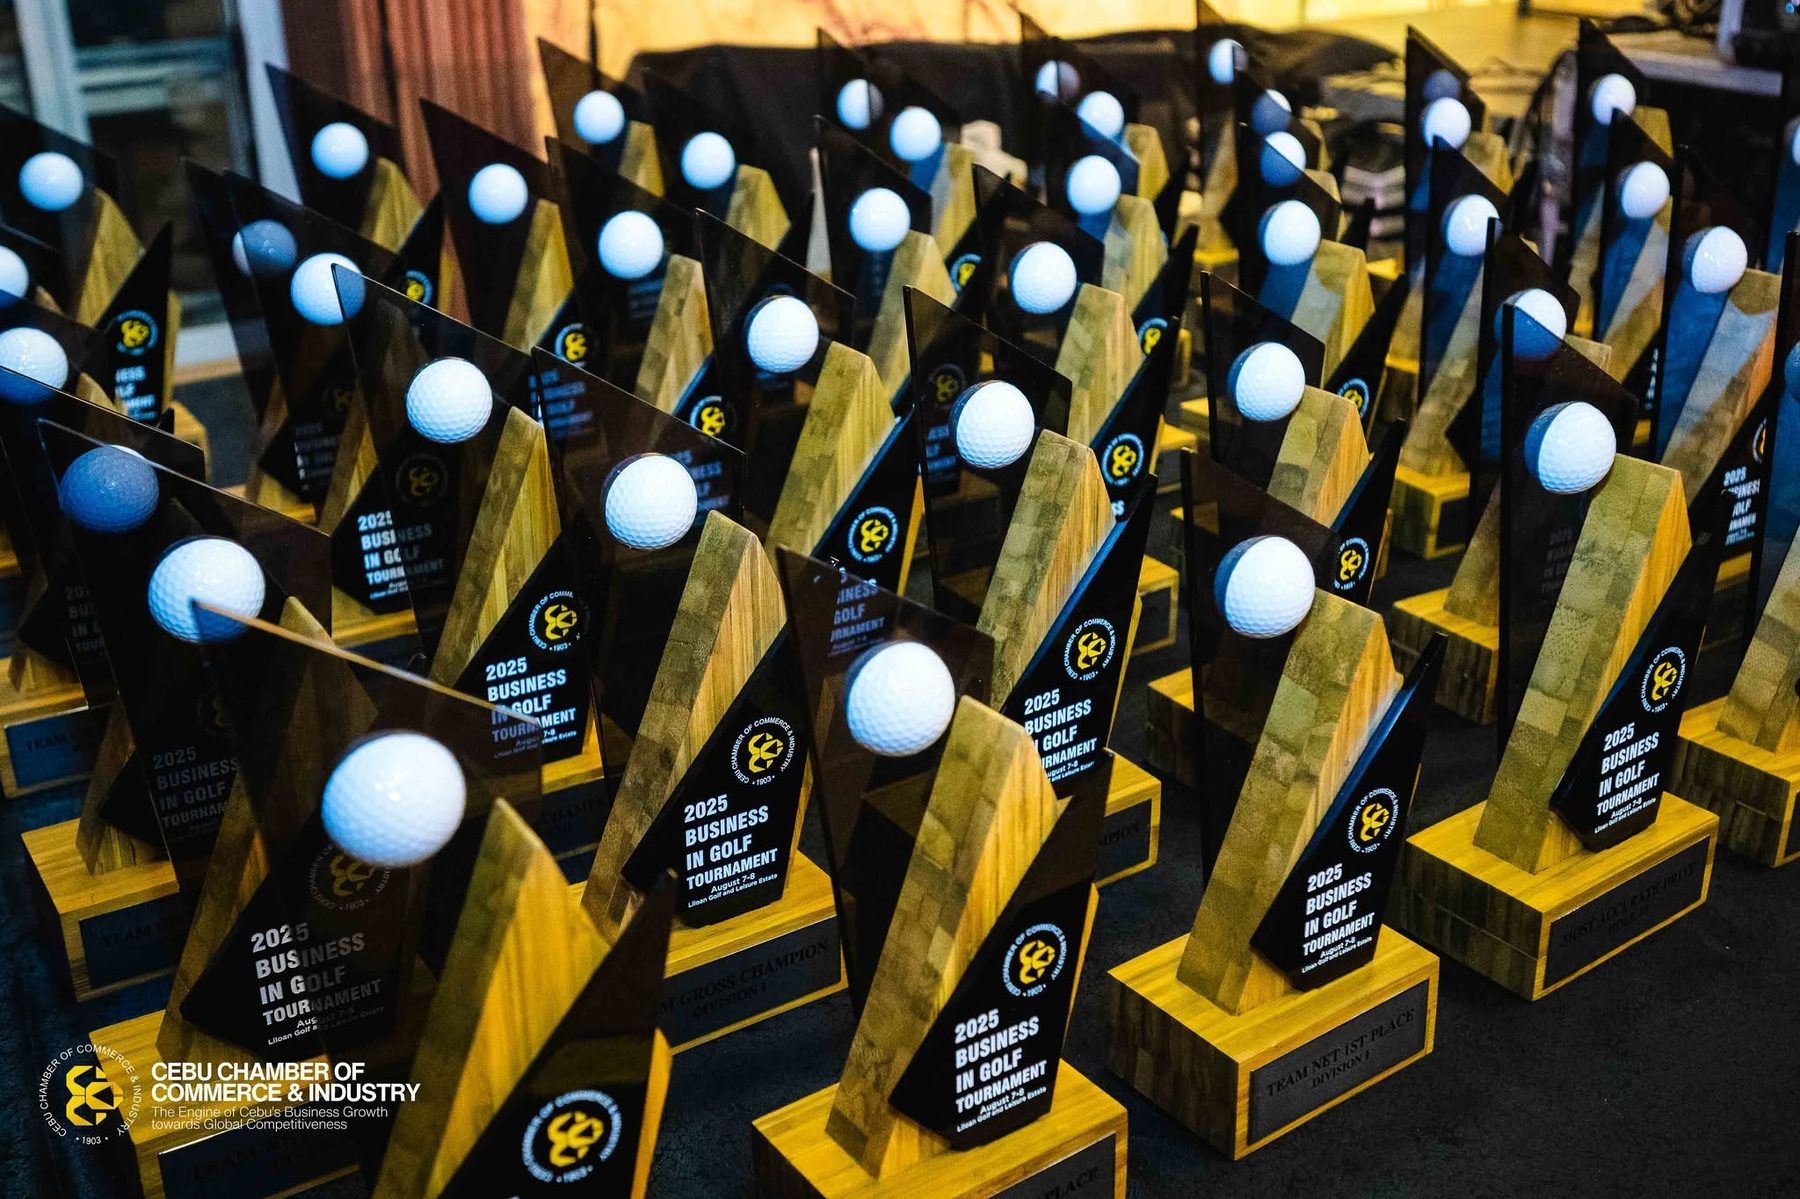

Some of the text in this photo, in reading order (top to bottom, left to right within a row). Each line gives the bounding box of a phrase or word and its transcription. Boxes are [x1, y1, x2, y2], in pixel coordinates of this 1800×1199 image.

[364, 552, 380, 570] IN
[528, 604, 541, 637] CHAMBER
[539, 596, 549, 606] OF
[486, 657, 528, 682] 2025
[487, 669, 567, 702] BUSINESS
[511, 693, 552, 716] GOLF
[1024, 688, 1060, 716] 2025
[1024, 699, 1092, 736] BUSINESS
[744, 724, 753, 735] OF
[753, 717, 790, 732] COMMERCE
[1042, 724, 1078, 752] GOLF
[1603, 722, 1635, 752] 2025
[152, 746, 197, 771] 2025
[731, 734, 744, 770] CHAMBER
[780, 735, 796, 772] INDUSTRY
[1601, 731, 1660, 775] BUSINESS
[155, 757, 238, 791] BUSINESS
[734, 769, 750, 785] CEBU
[756, 775, 772, 786] 1903
[1598, 760, 1646, 798] IN GOLF
[159, 783, 227, 812] IN GOLF
[684, 794, 728, 823] 2025
[1597, 772, 1660, 817] TOURNAMENT
[1611, 797, 1642, 819] August 7-8
[685, 805, 769, 847] BUSINESS
[1348, 804, 1361, 838] CHAMBER
[1360, 795, 1368, 805] OF
[686, 834, 753, 870] IN GOLF
[686, 847, 778, 890] TOURNAMENT
[688, 873, 778, 908] Liloan Golf and Leisure Estate
[711, 872, 756, 894] August 7-8
[1306, 872, 1372, 916] BUSINESS
[1307, 863, 1343, 893] 2025
[1302, 912, 1375, 956] TOURNAMENT
[1304, 900, 1358, 938] IN GOLF
[250, 922, 310, 953] 2025
[255, 931, 365, 979] BUSINESS
[1320, 936, 1356, 959] August 7-8
[259, 965, 347, 1005] IN GOLF
[681, 974, 736, 1006] GROSS
[741, 940, 828, 983] CHAMPION
[262, 979, 382, 1026] TOURNAMENT
[268, 1026, 311, 1046] Liloan Golf
[955, 1008, 999, 1044] 2025
[956, 1016, 1039, 1069] BUSINESS
[1267, 1066, 1308, 1097] TEAM
[1312, 1048, 1340, 1073] NET
[1371, 1008, 1415, 1041] PLACE
[956, 1048, 1022, 1094] IN GOLF
[956, 1060, 1047, 1113] TOURNAMENT
[1312, 1055, 1361, 1089] DIVISION
[980, 1088, 1025, 1115] August 7-8
